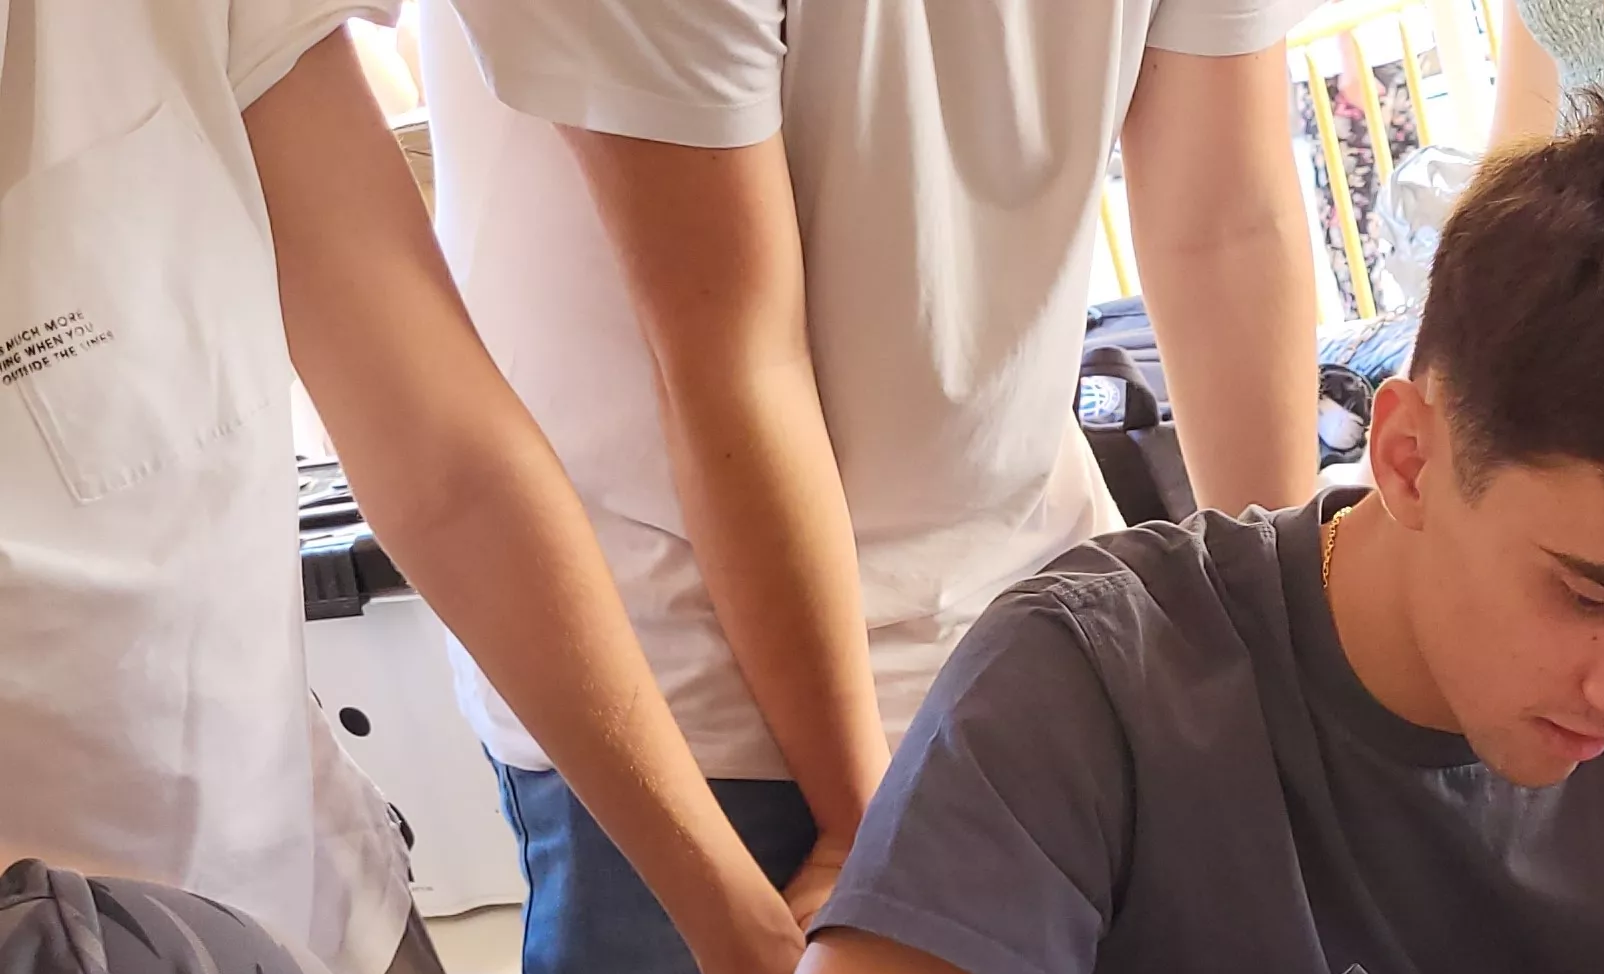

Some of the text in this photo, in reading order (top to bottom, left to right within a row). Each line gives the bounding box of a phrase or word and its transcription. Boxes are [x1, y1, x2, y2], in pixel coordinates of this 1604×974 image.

[0, 321, 94, 373] ING WHEN YOU
[6, 326, 41, 351] MUCH
[44, 310, 84, 331] MORE
[2, 357, 51, 386] OUTSIDE
[53, 346, 78, 361] THE
